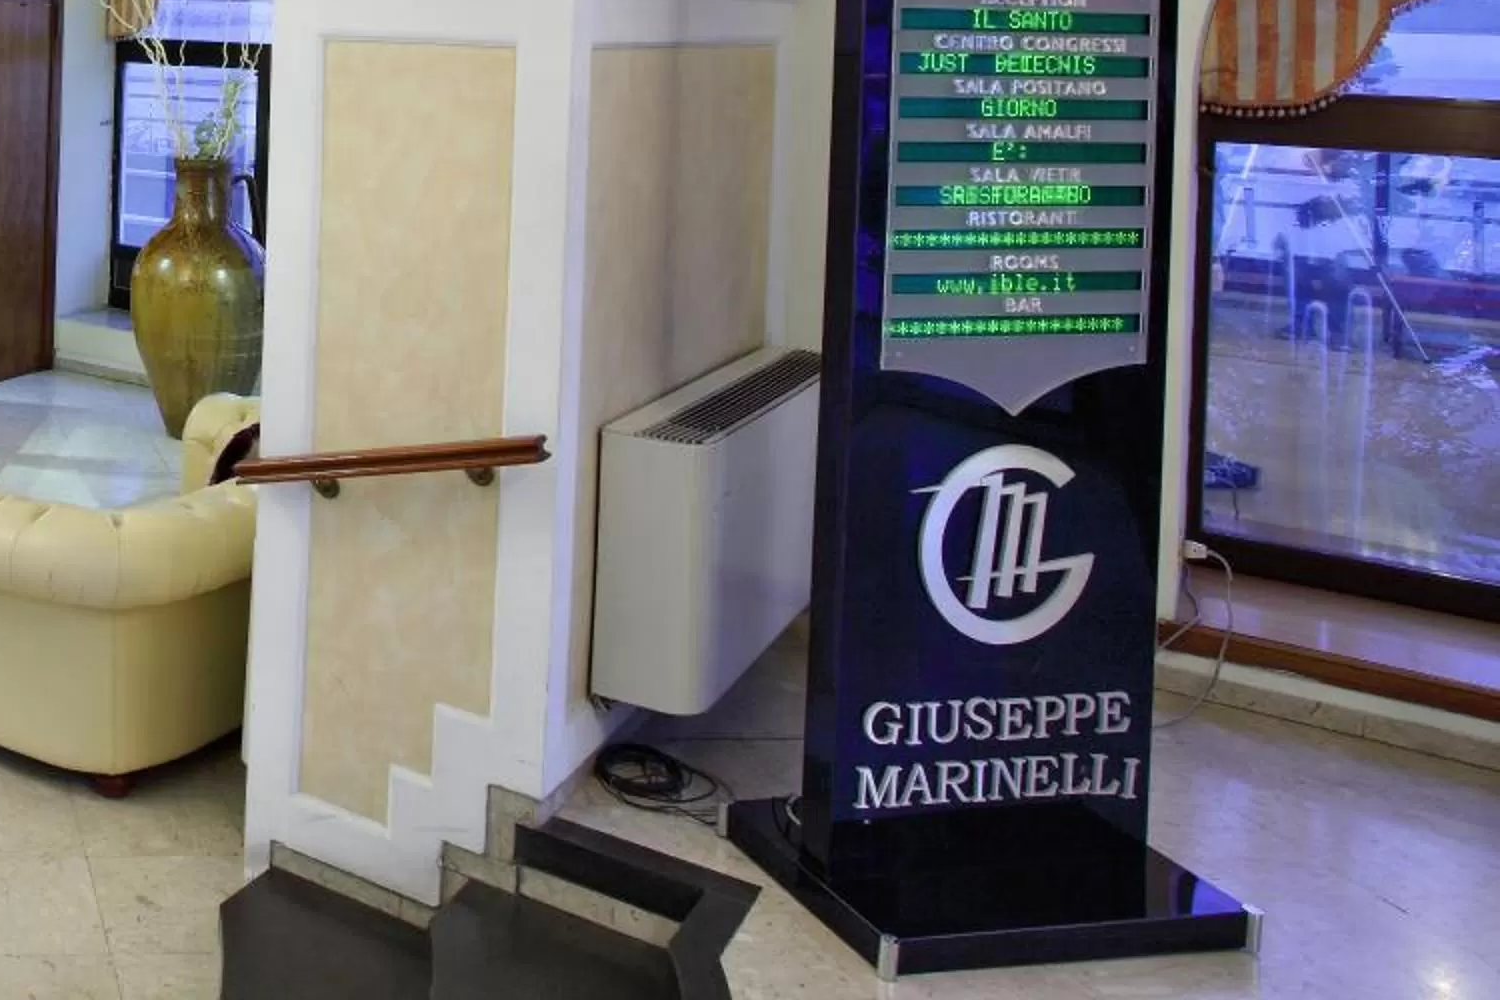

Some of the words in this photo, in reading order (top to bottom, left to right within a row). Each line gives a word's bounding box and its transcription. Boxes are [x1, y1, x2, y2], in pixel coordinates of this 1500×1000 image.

[971, 8, 997, 29] IL
[1008, 10, 1073, 30] SANTO
[934, 34, 1013, 51] CENTRO
[1021, 37, 1128, 53] CONGRESSI
[917, 53, 969, 73] JUST
[953, 79, 1004, 95] SALA
[1011, 80, 1107, 96] POSITANO
[980, 100, 1058, 118] GIORNO
[965, 123, 1019, 140] SALA
[1023, 124, 1092, 141] AMALFI
[969, 166, 1020, 183] SALA
[989, 255, 1061, 271] ROOMS
[1004, 296, 1043, 314] BAR
[861, 691, 1132, 746] GIUSEPPE
[853, 752, 1141, 810] MARINELLI
